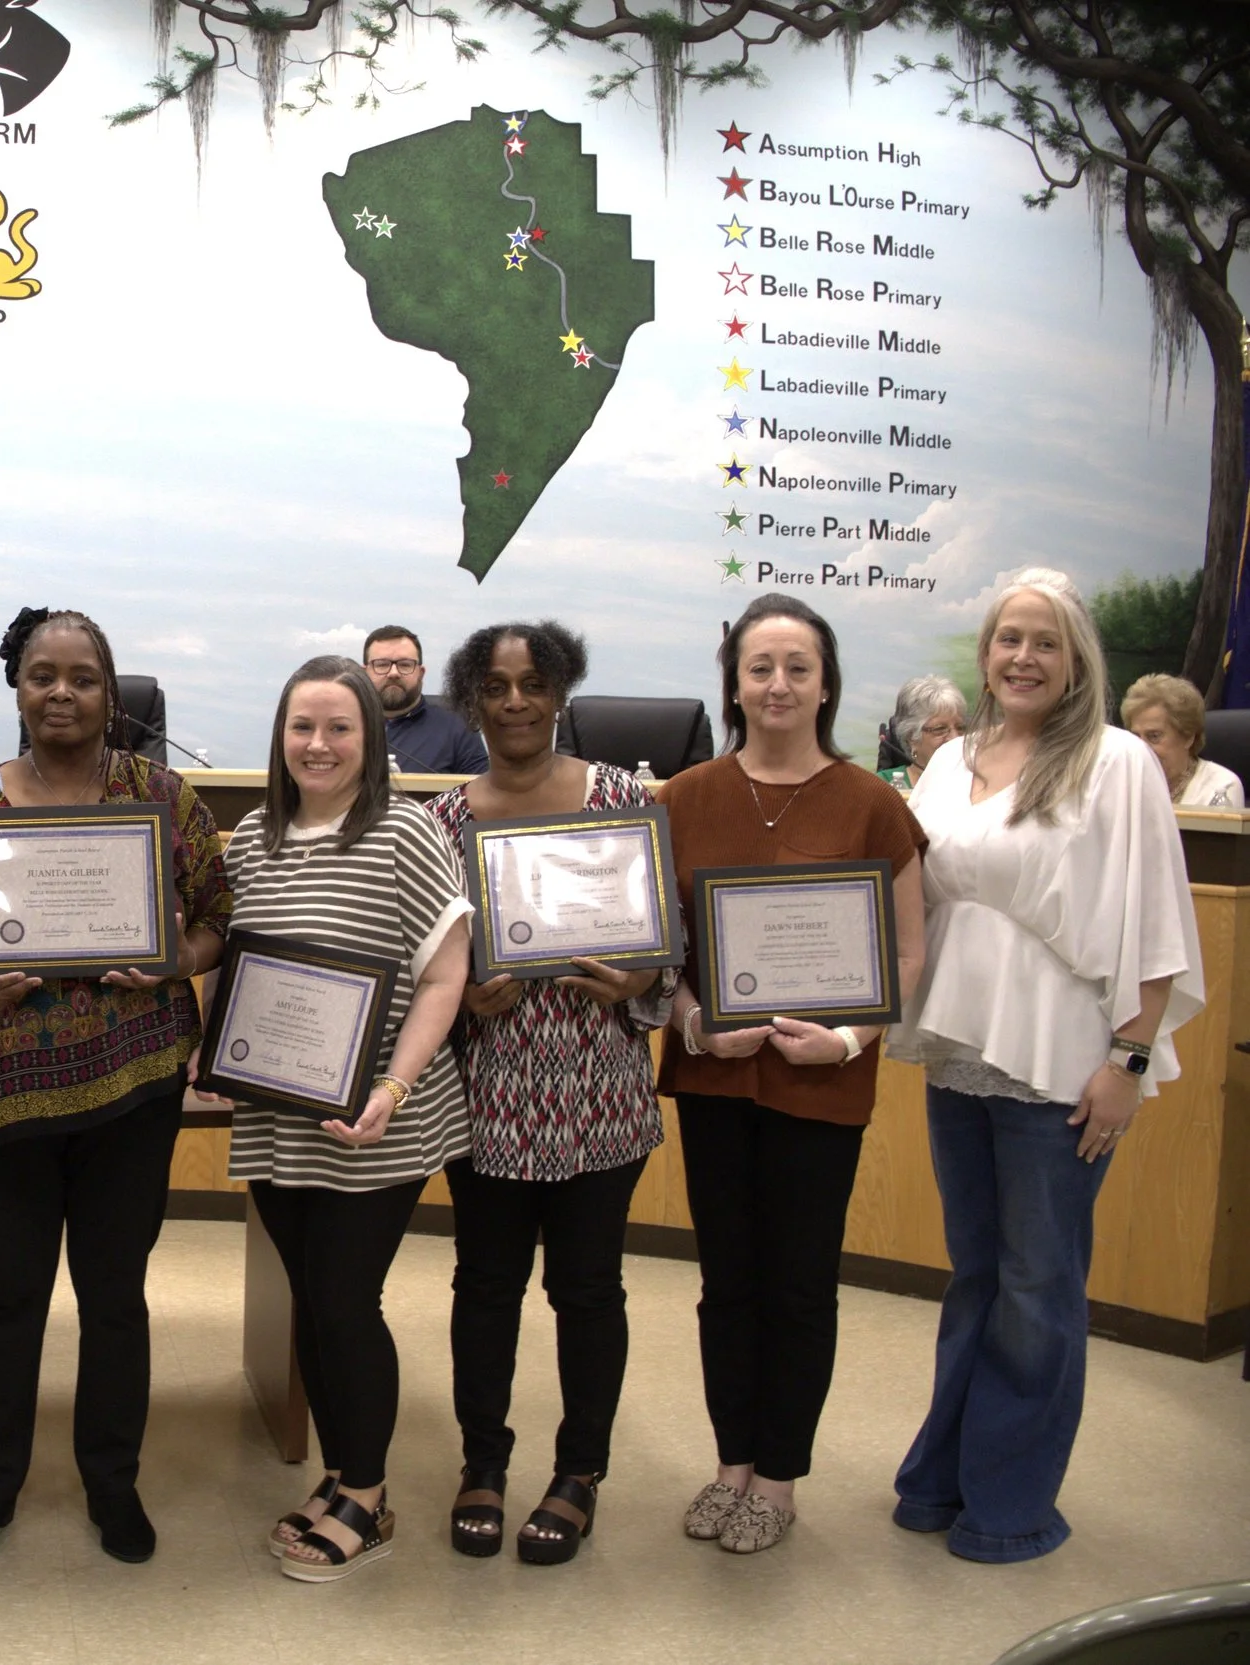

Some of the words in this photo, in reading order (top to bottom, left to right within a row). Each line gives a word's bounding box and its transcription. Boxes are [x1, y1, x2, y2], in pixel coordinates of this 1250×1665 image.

[758, 132, 869, 161] Assumption
[878, 141, 921, 167] High
[759, 179, 821, 206] Bayou
[829, 183, 895, 209] L'Ourse
[901, 190, 970, 219] Primary
[759, 226, 809, 250] Belle
[816, 230, 865, 254] Rose
[873, 234, 935, 259] Middle
[760, 274, 808, 297] Belle
[816, 277, 865, 301] Rose
[873, 280, 942, 309] Primary
[761, 322, 870, 350] Labadieville
[878, 329, 941, 354] Middle
[760, 369, 870, 396] Labadieville
[878, 376, 947, 404] Primary
[759, 416, 883, 445] Napoleonville
[889, 424, 952, 449] Middle
[759, 465, 882, 492] Napoleonville
[888, 471, 957, 499] Primary
[758, 513, 816, 537] Pierre
[823, 516, 861, 539] Part
[869, 518, 931, 542] Middle
[757, 561, 815, 584] Pierre
[821, 563, 860, 586] Part
[867, 565, 937, 592] Primary
[27, 868, 68, 878] JUANITA
[69, 868, 111, 877] GILBERT
[763, 922, 793, 932] DAWN
[793, 921, 830, 931] HEBERT
[274, 999, 293, 1010] AMY
